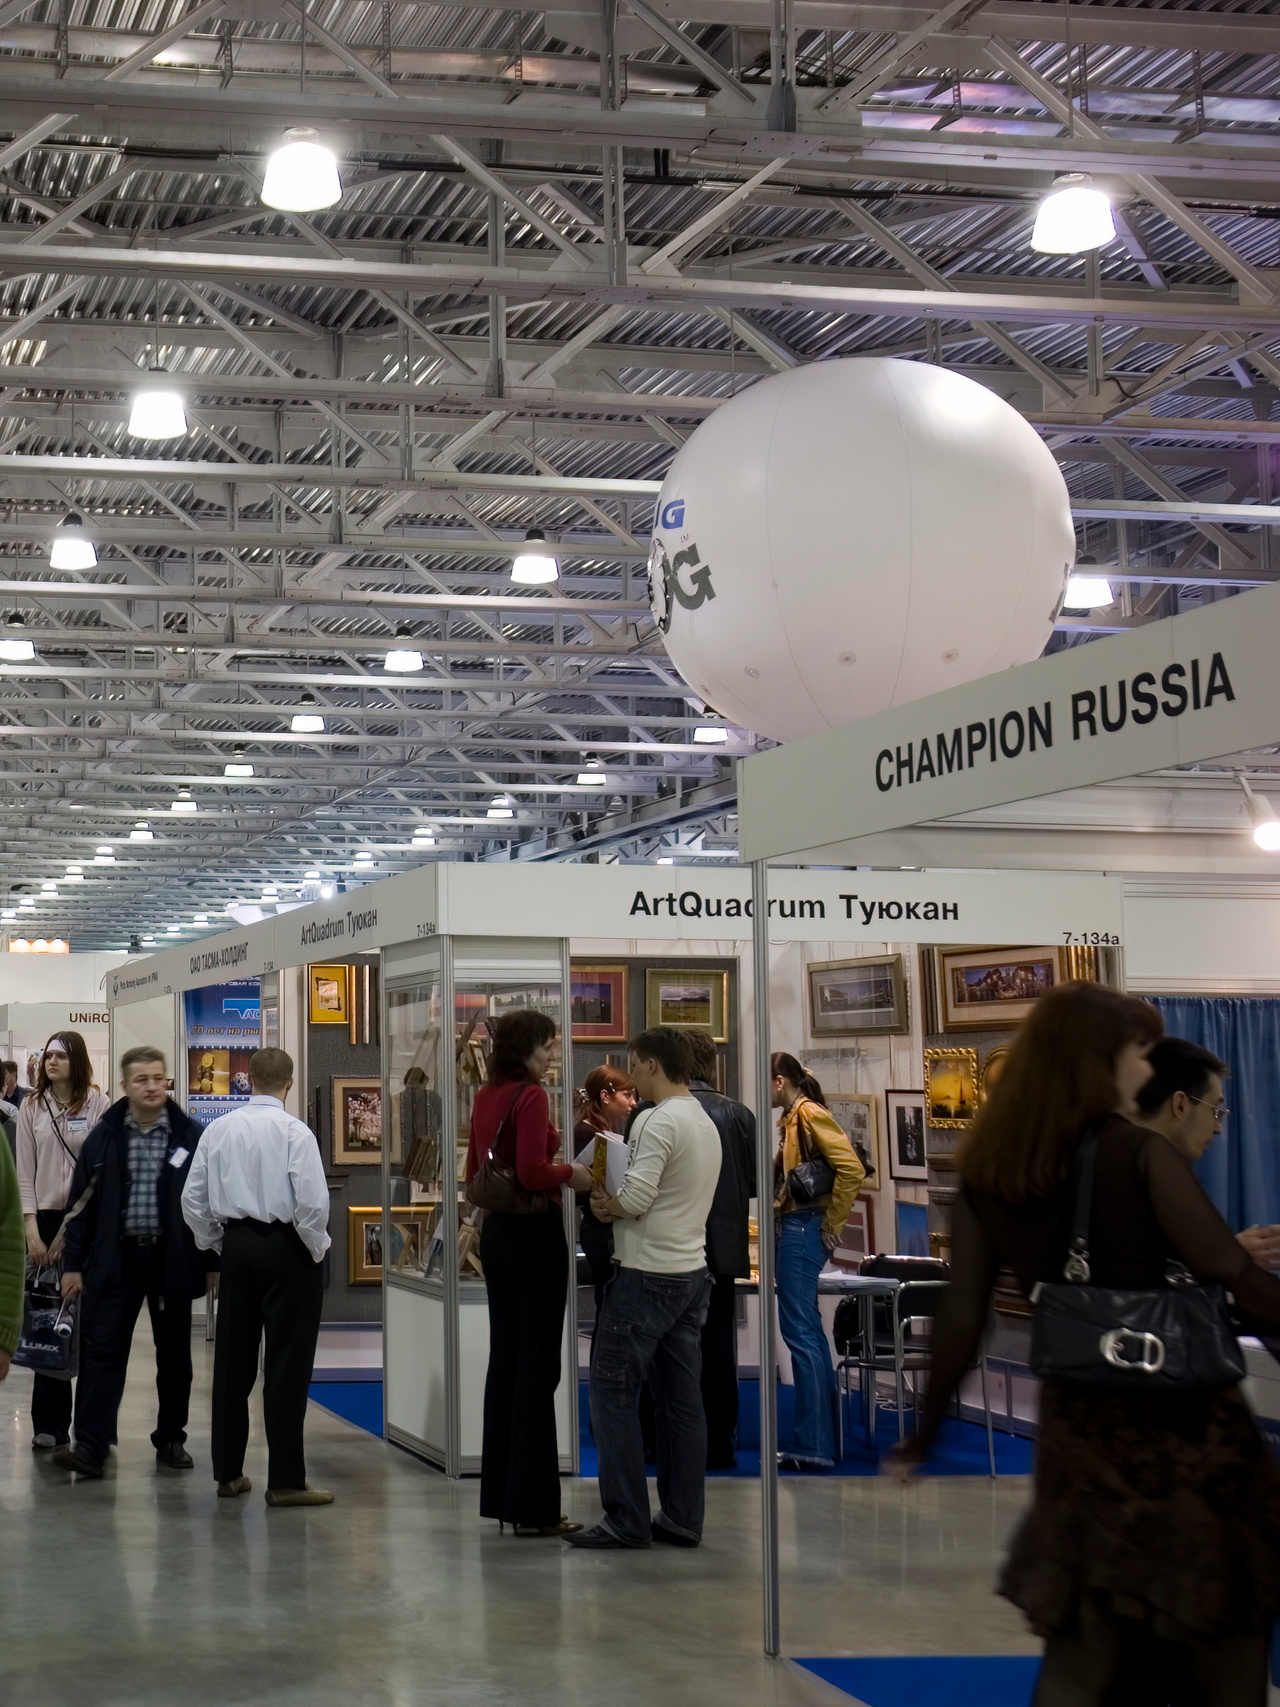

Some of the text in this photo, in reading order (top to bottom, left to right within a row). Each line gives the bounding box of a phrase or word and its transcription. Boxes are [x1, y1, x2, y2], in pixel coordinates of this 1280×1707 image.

[875, 651, 1236, 792] CHAMPION RUSSIA
[839, 894, 959, 925] Туюкан
[301, 909, 378, 946] ArtQuadrum Туюкан
[417, 922, 436, 937] 7-134a
[1062, 932, 1120, 945] 7-134a
[190, 957, 201, 974] ОАО
[191, 1025, 204, 1035] 70
[206, 1027, 225, 1036] лет
[227, 1027, 240, 1035] на
